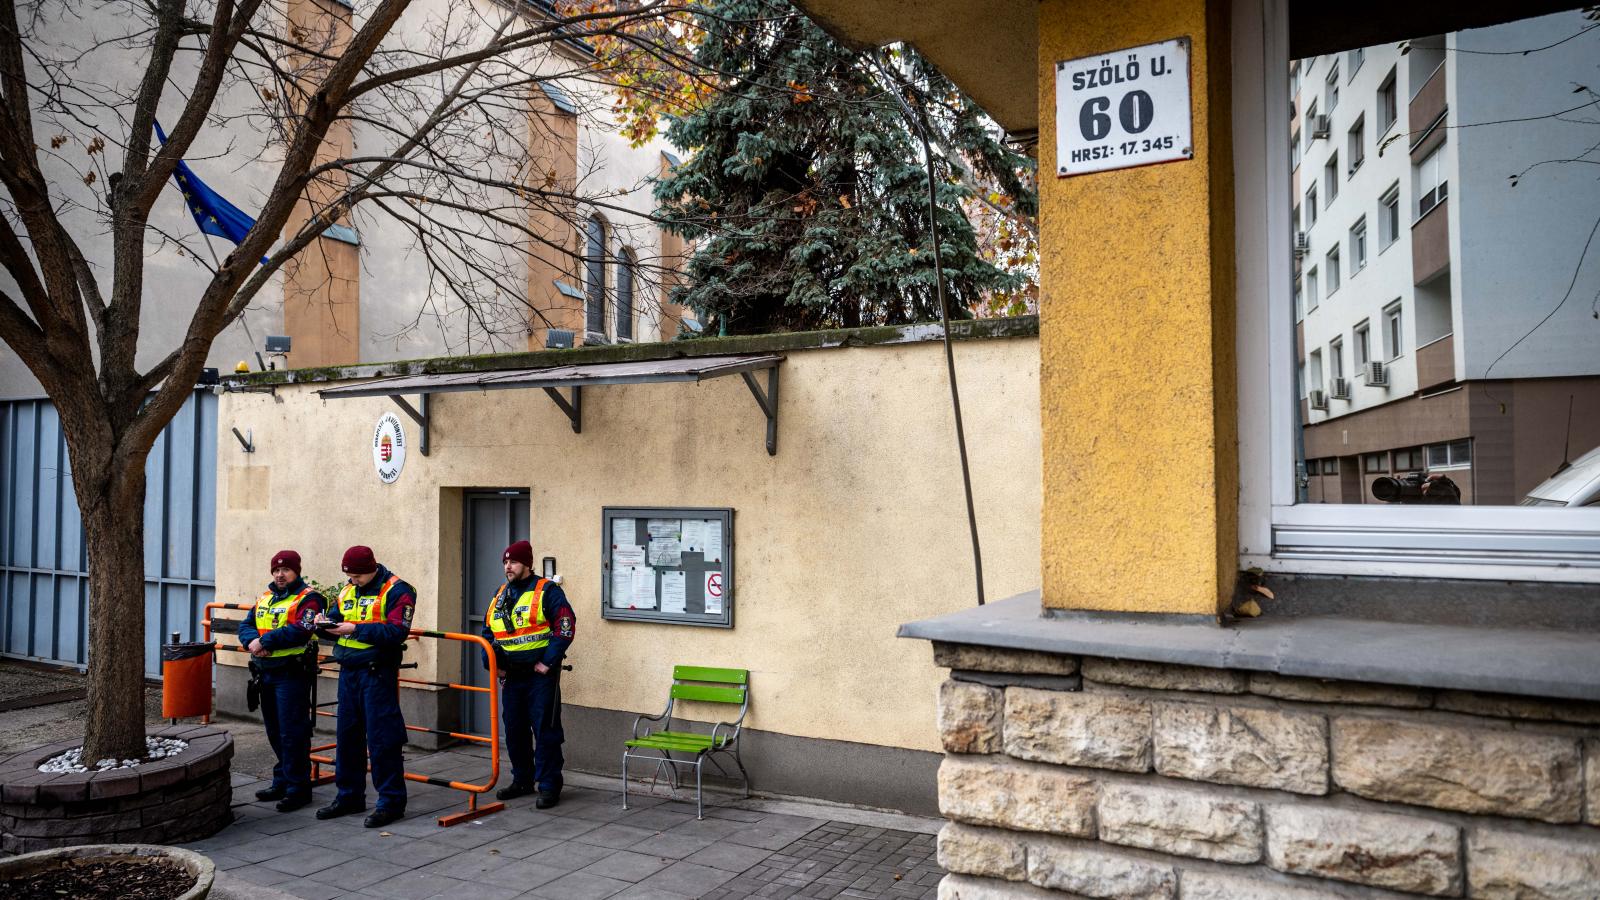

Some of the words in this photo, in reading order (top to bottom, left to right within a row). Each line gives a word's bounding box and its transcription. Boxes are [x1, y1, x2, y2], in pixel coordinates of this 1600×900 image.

[1072, 54, 1140, 91] SZŐLŐ
[1150, 55, 1172, 77] U.
[1079, 89, 1154, 141] 60
[1071, 145, 1114, 163] HRSZ:
